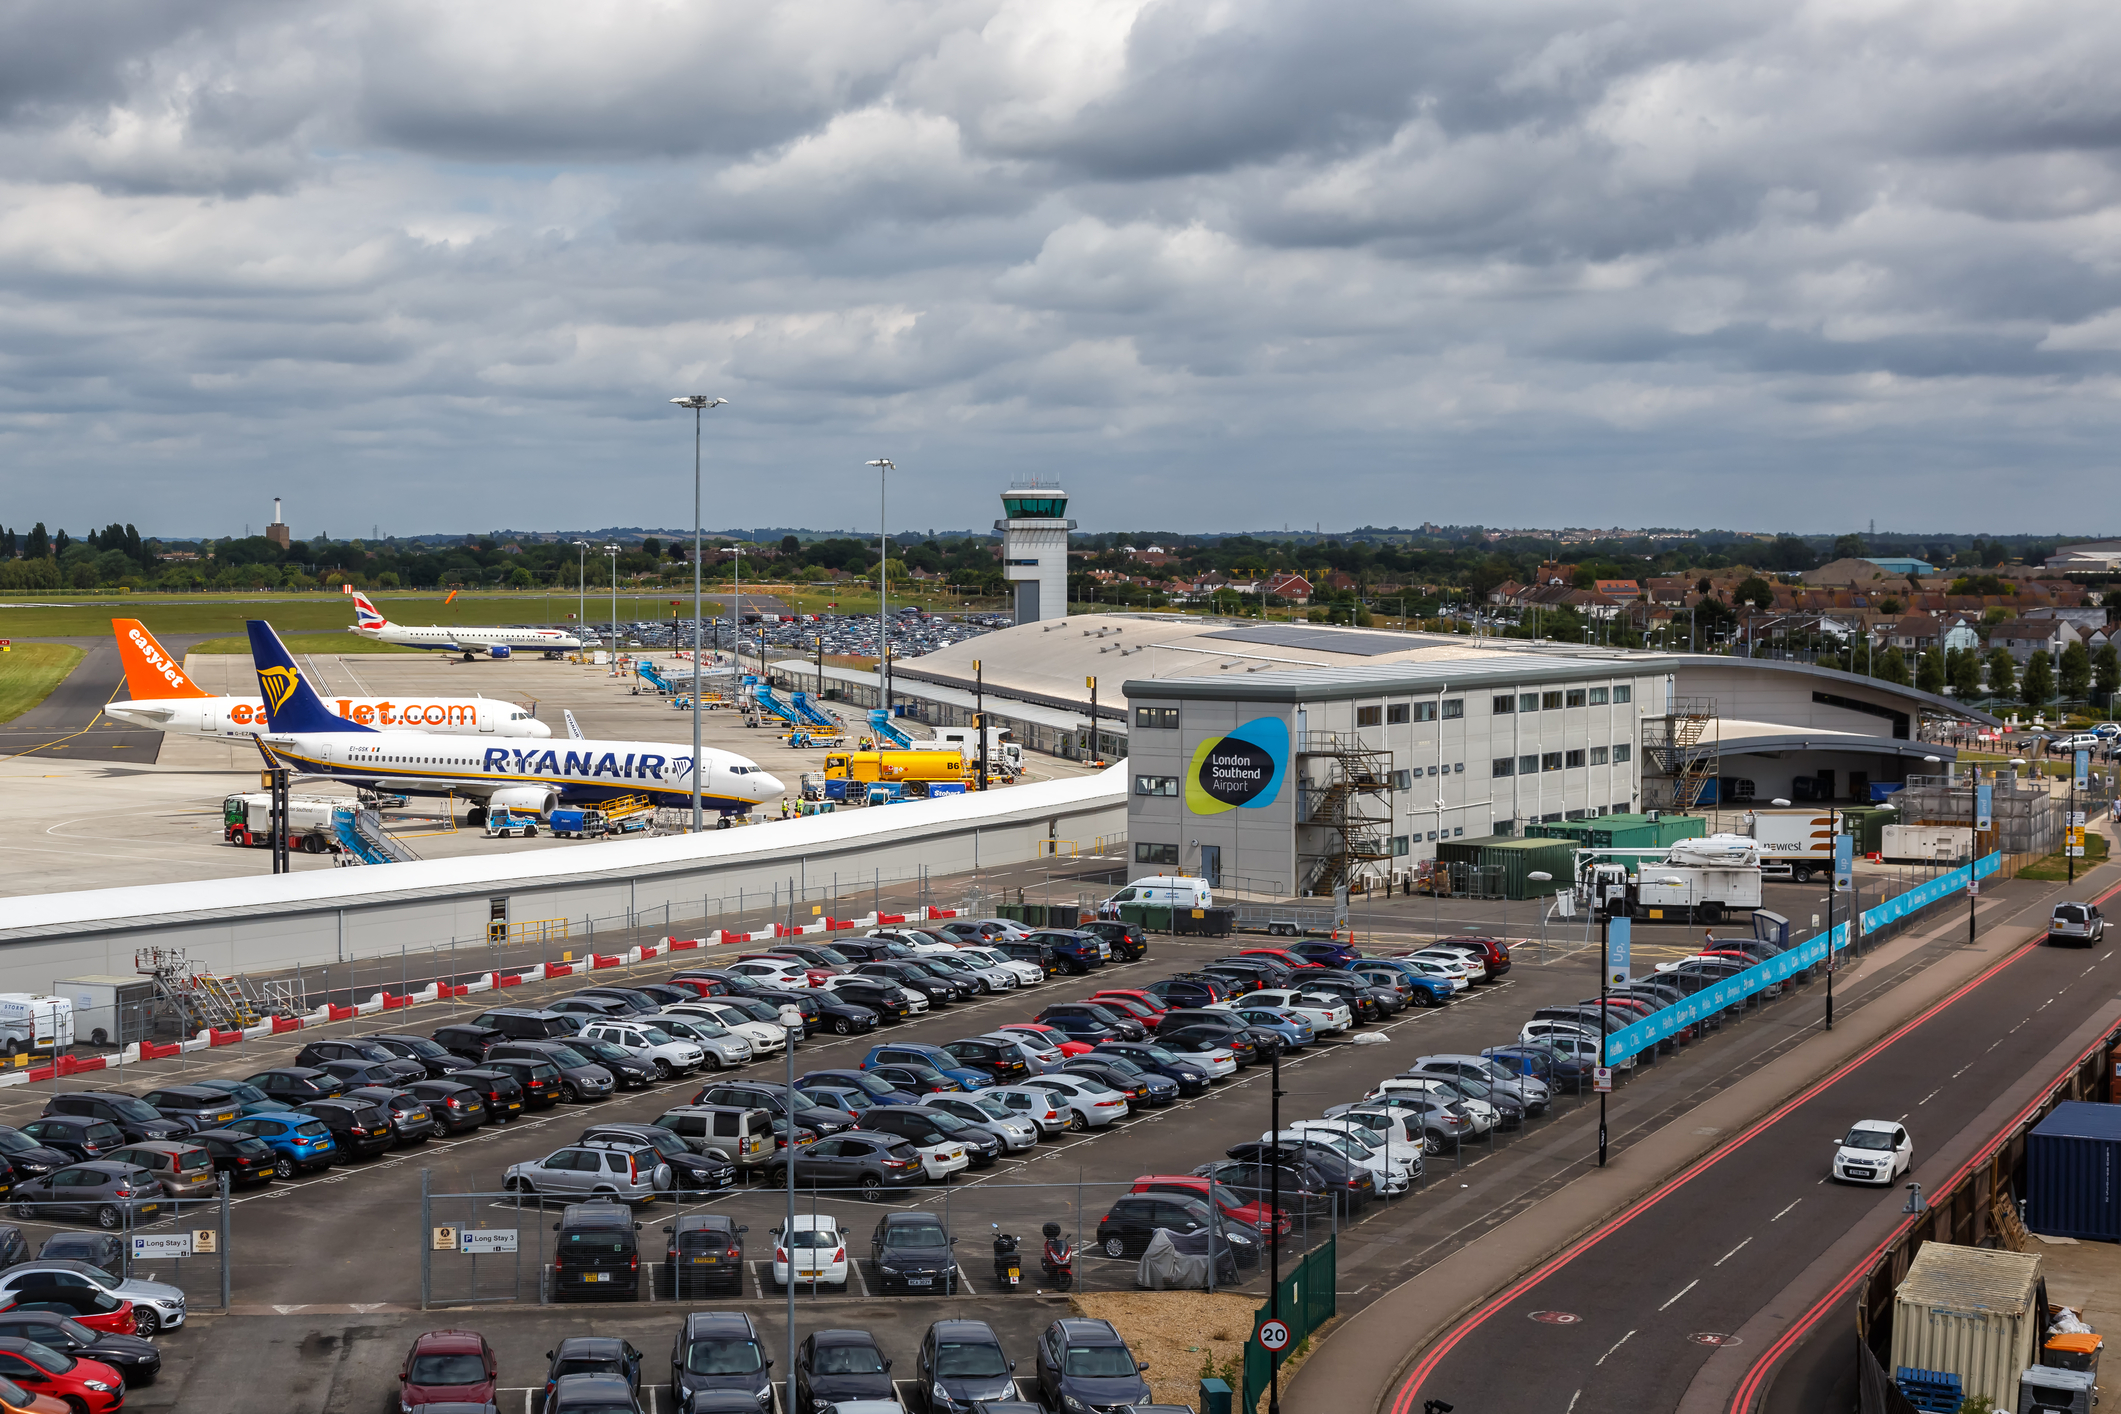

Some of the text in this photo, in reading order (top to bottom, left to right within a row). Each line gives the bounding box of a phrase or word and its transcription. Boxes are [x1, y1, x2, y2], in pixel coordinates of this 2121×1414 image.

[129, 629, 184, 688] easyJet
[230, 699, 477, 726] eaJet.com
[566, 714, 580, 739] RYANAIR
[255, 737, 277, 766] RYANAIR
[1212, 754, 1250, 766] London
[483, 748, 666, 780] RYANAIR
[1212, 766, 1260, 779] Southend
[1212, 779, 1248, 793] Airport
[1764, 841, 1802, 851] newrest
[1841, 858, 1849, 870] up
[1613, 942, 1626, 962] Up,
[1263, 1328, 1285, 1342] 20
